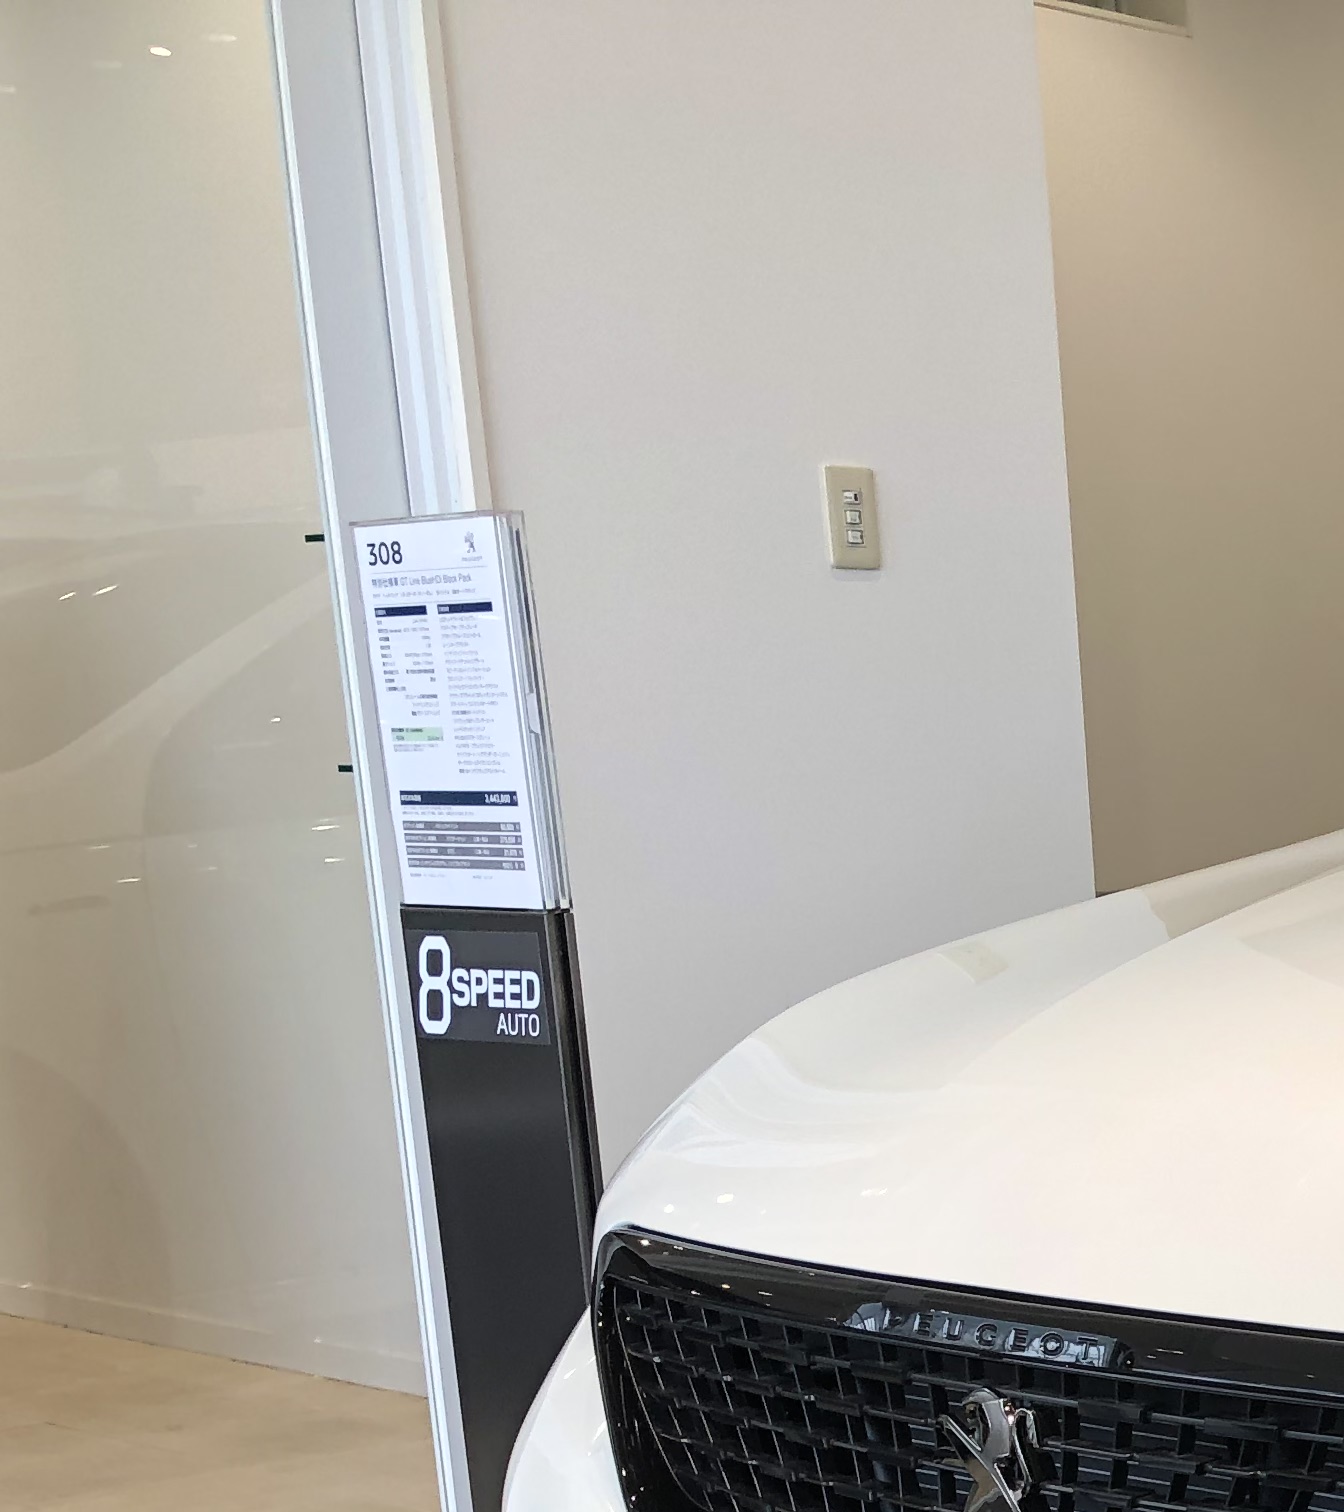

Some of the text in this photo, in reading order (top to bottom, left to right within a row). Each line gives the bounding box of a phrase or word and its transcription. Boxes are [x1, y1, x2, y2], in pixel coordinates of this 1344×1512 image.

[366, 541, 403, 566] 308
[419, 935, 541, 1035] 8 SPEED
[496, 1013, 540, 1037] AUTO
[882, 1306, 1099, 1361] PEUGEOT
